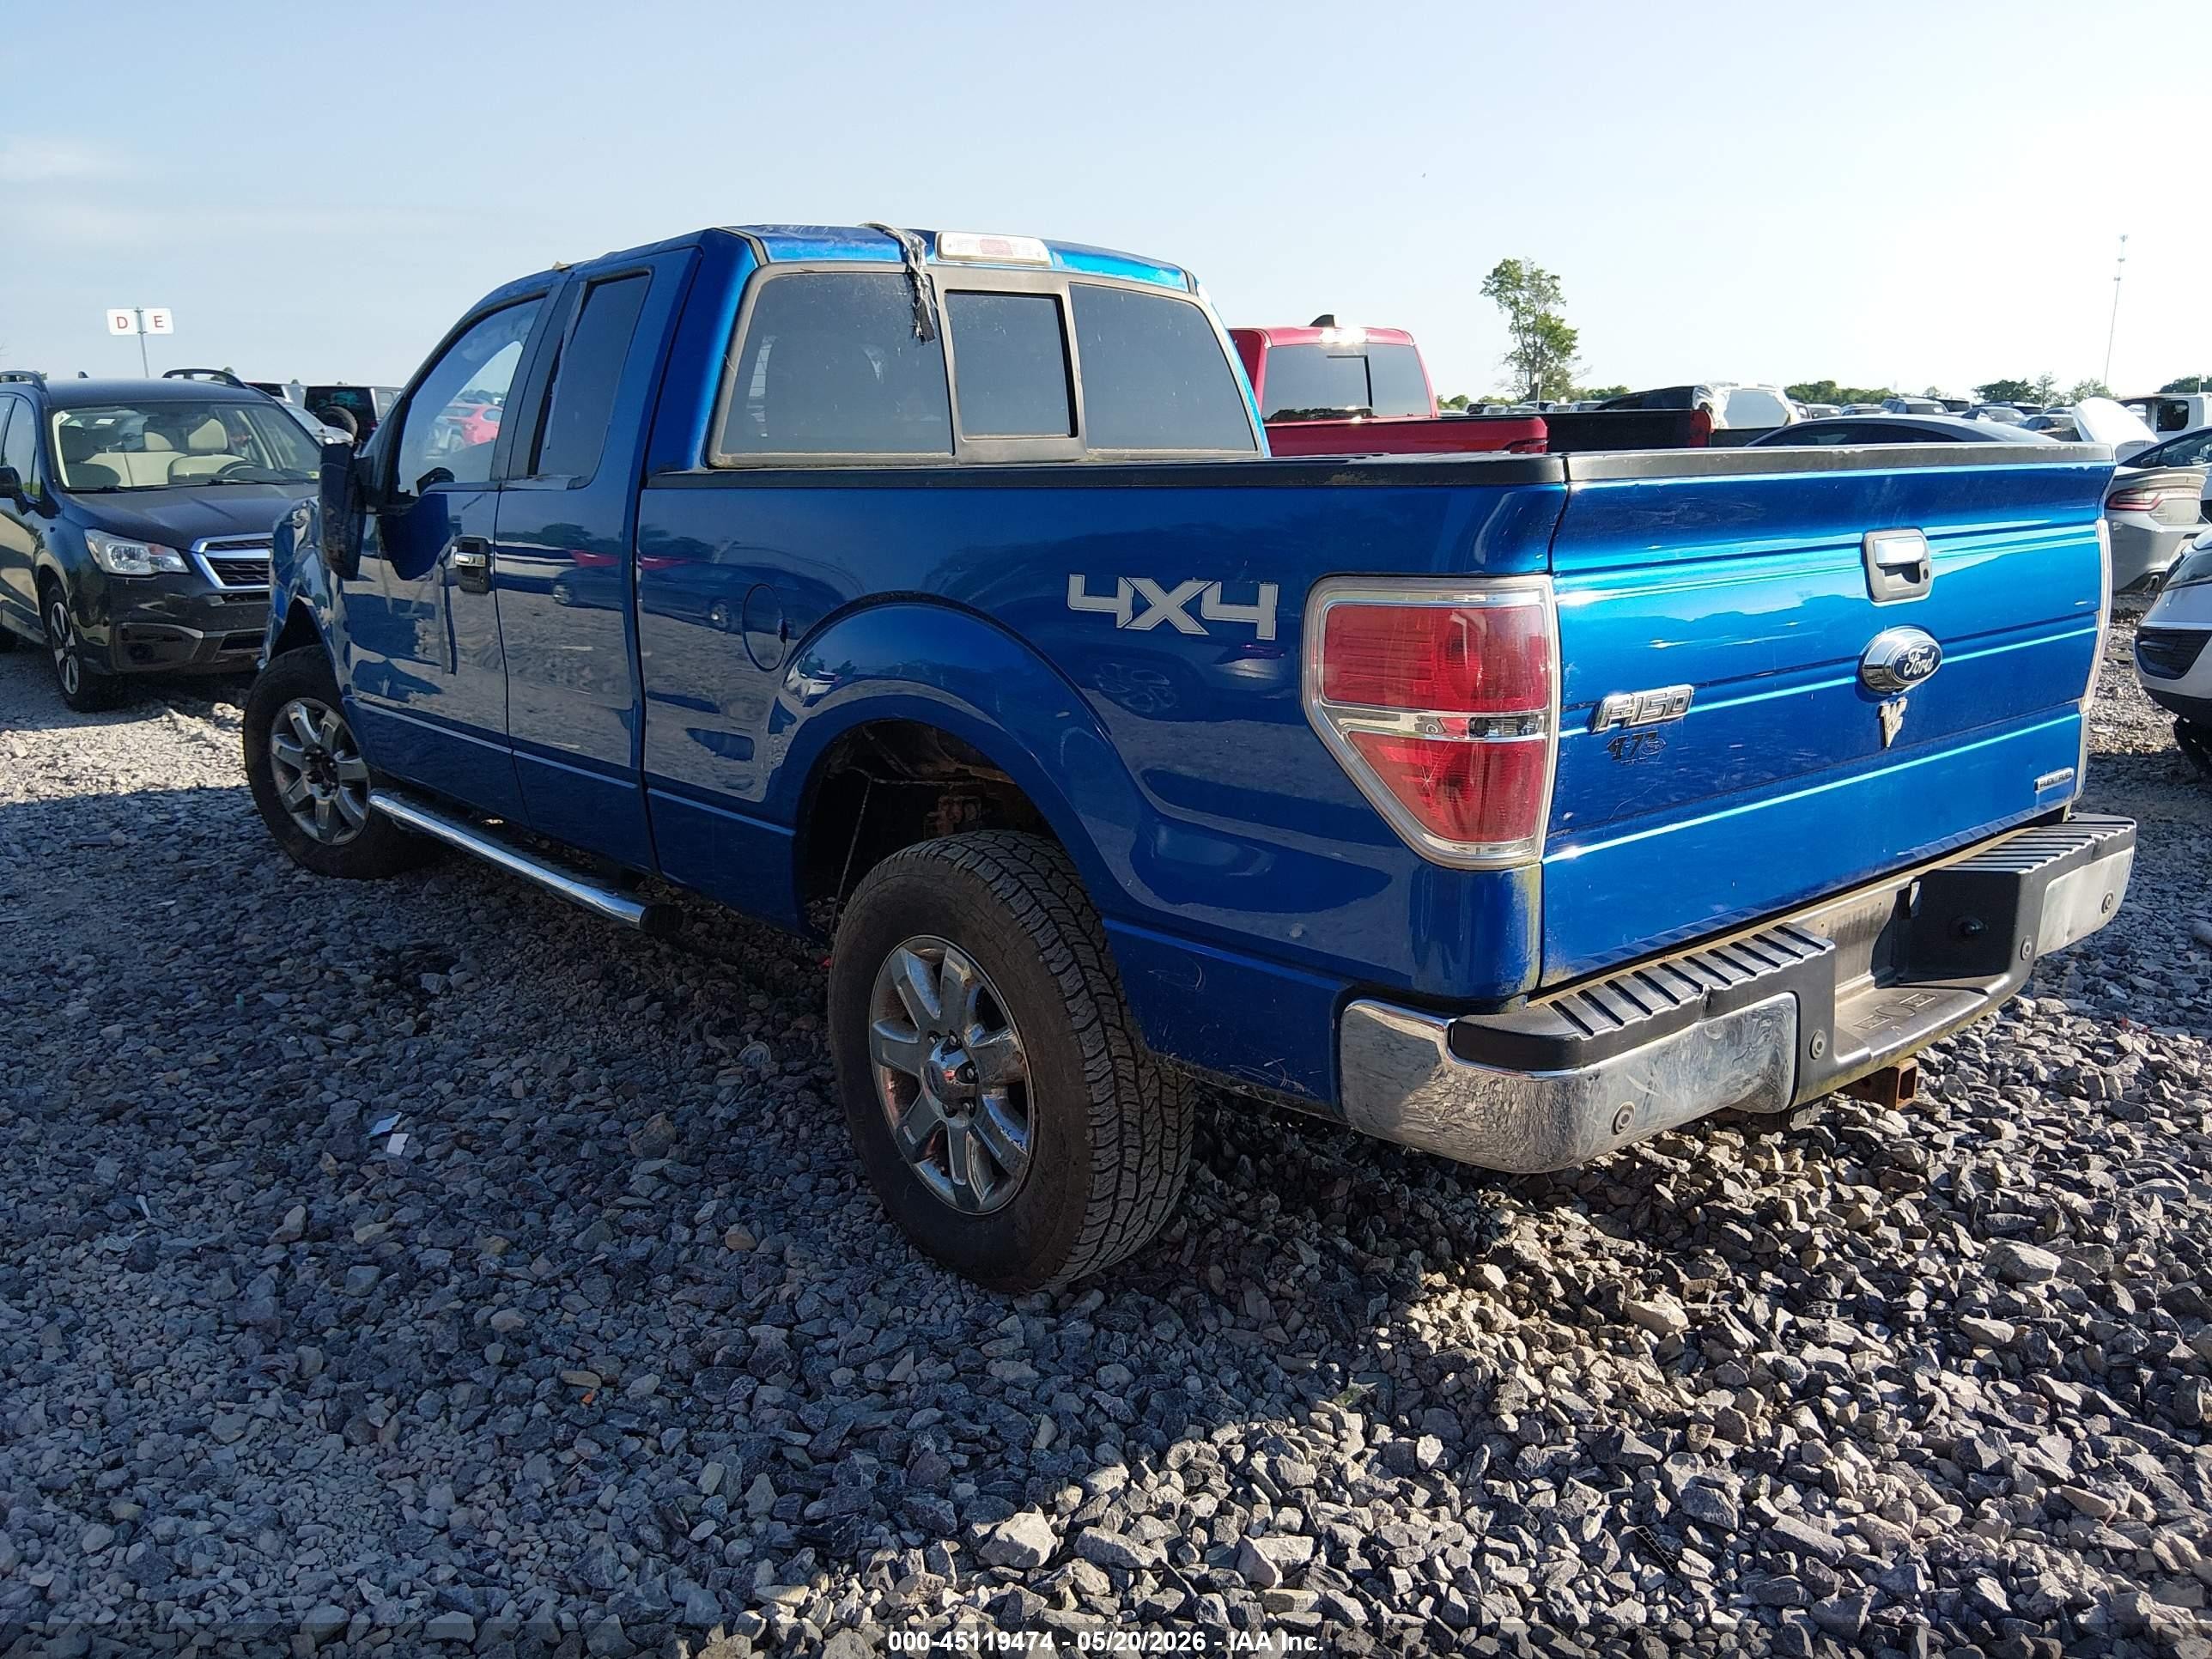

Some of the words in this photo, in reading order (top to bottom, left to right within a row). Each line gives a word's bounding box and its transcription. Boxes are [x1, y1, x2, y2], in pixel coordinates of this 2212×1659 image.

[117, 316, 128, 329] D
[154, 315, 165, 328] E
[1903, 647, 1936, 677] Ford
